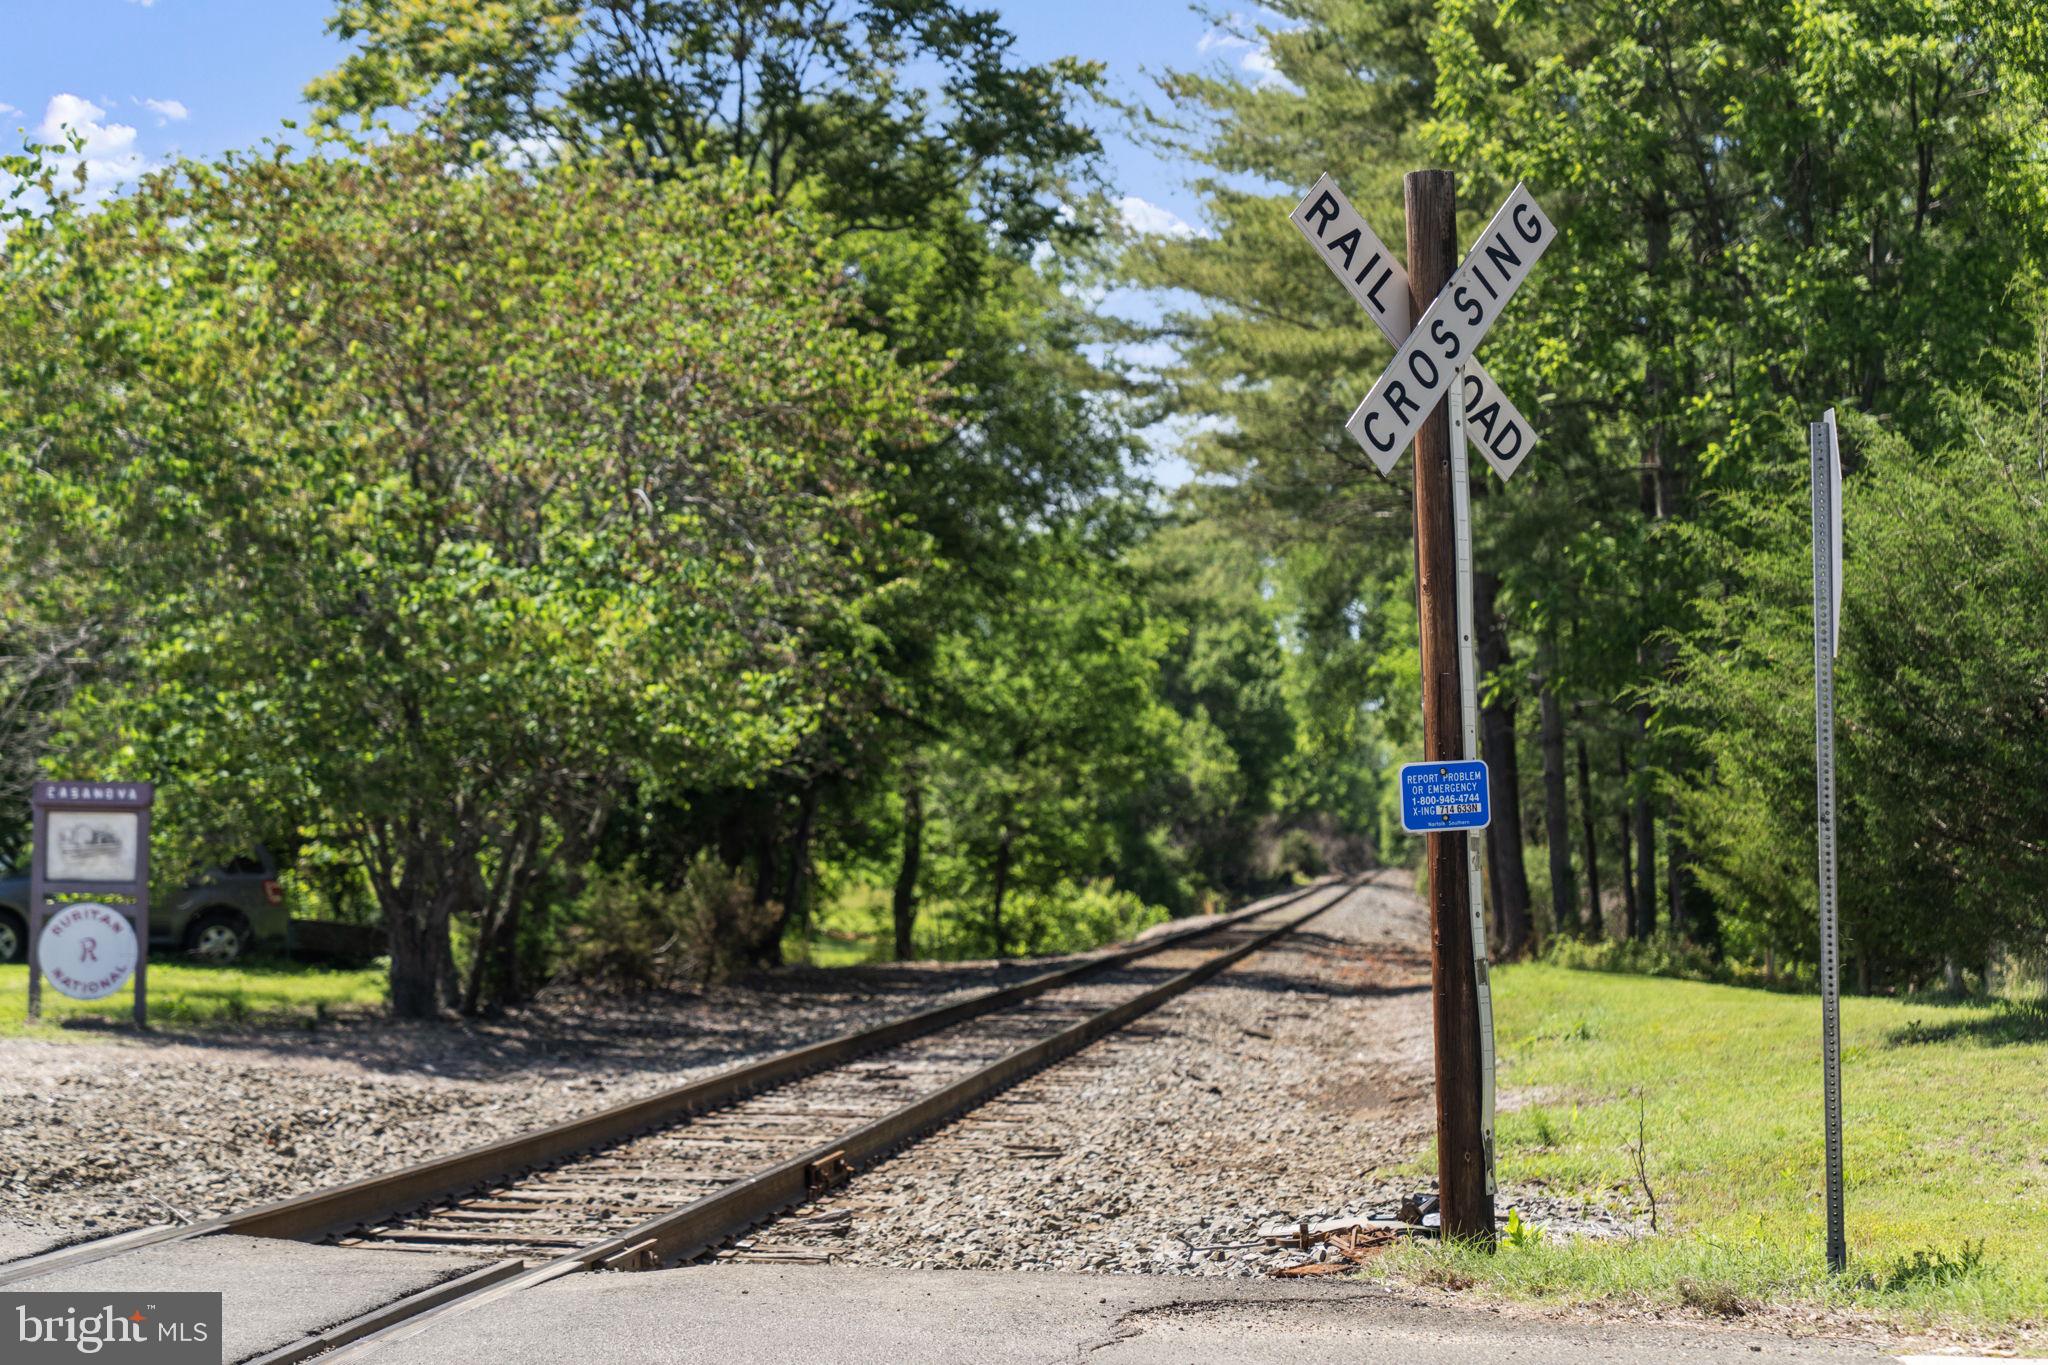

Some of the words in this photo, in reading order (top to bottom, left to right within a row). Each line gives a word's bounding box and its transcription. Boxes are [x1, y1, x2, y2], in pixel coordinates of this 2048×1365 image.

[1304, 190, 1393, 314] RAIL
[1464, 375, 1522, 461] OAD
[1364, 203, 1542, 453] CROSSING
[1407, 774, 1438, 784] REPORT
[1443, 771, 1481, 782] PROBLEM
[47, 786, 137, 800] CASANOVA
[1412, 785, 1423, 795] OR
[1427, 783, 1477, 794] EMERGENCY
[1412, 793, 1479, 806] 1-800-946-4744
[1413, 806, 1435, 816] X-ING
[1440, 805, 1454, 814] 714
[1457, 804, 1478, 813] 633N
[80, 937, 97, 962] R
[52, 966, 128, 993] NATIONAL
